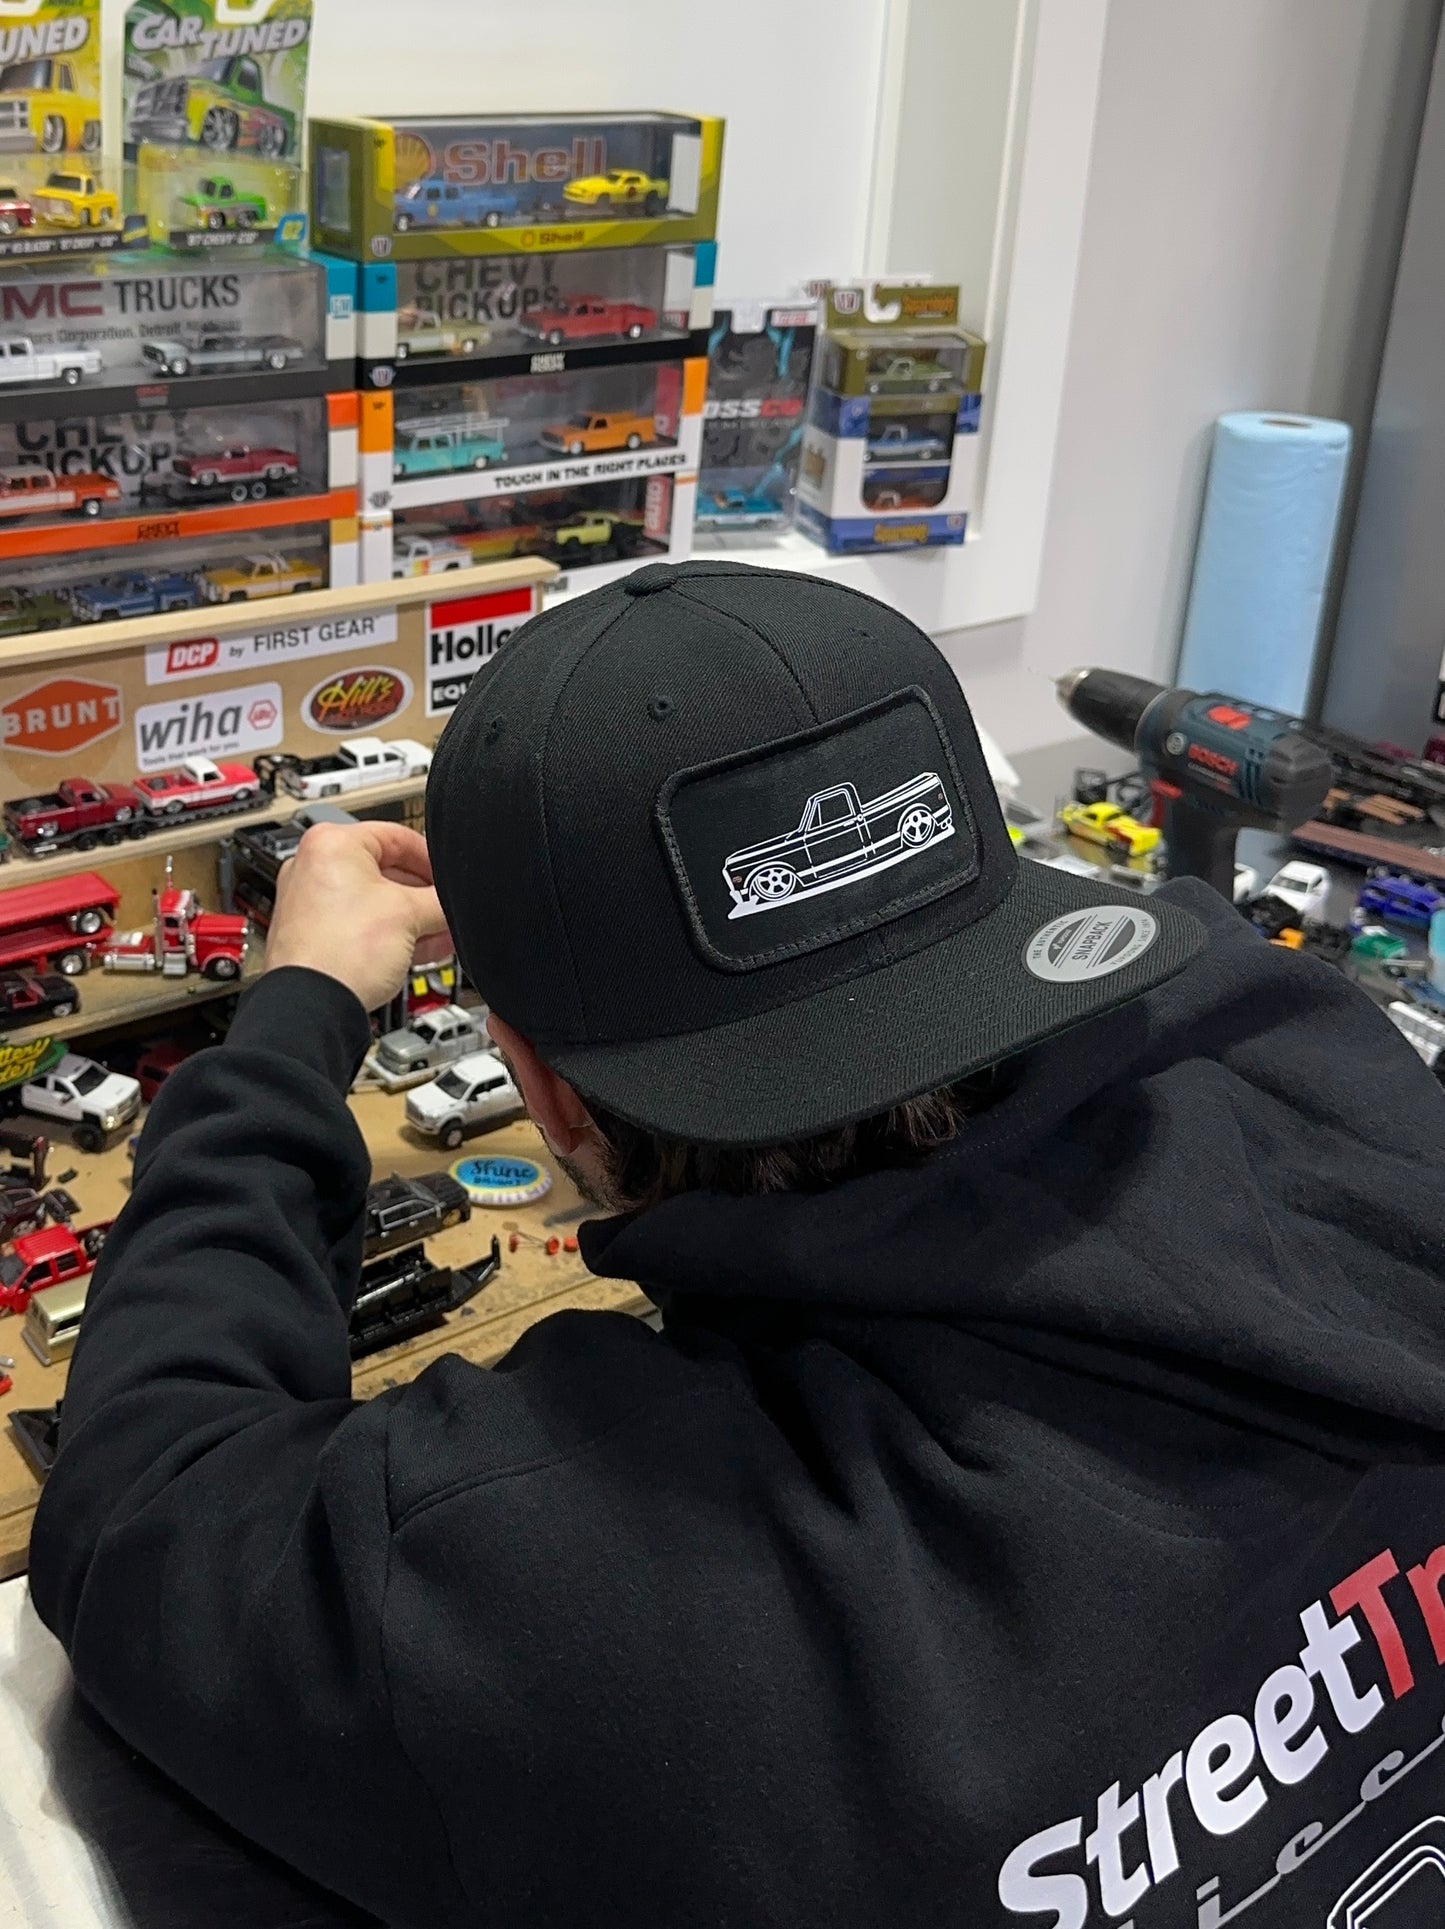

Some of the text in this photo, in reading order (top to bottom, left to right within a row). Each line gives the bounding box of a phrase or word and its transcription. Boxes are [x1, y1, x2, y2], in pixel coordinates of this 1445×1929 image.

[444, 136, 607, 186] Shell
[114, 275, 241, 314] TRUCKS
[495, 454, 687, 489] TOUGH IN THE RIGHT PLACES
[171, 617, 375, 668] DCP by FIRST GEAR
[0, 696, 119, 736] BRUNT
[141, 702, 242, 752] wiha
[1188, 743, 1239, 776] BOSCH
[1037, 919, 1069, 948] AUTHENTIC
[1072, 920, 1113, 961] SNAPBACK
[1033, 949, 1042, 960] THE
